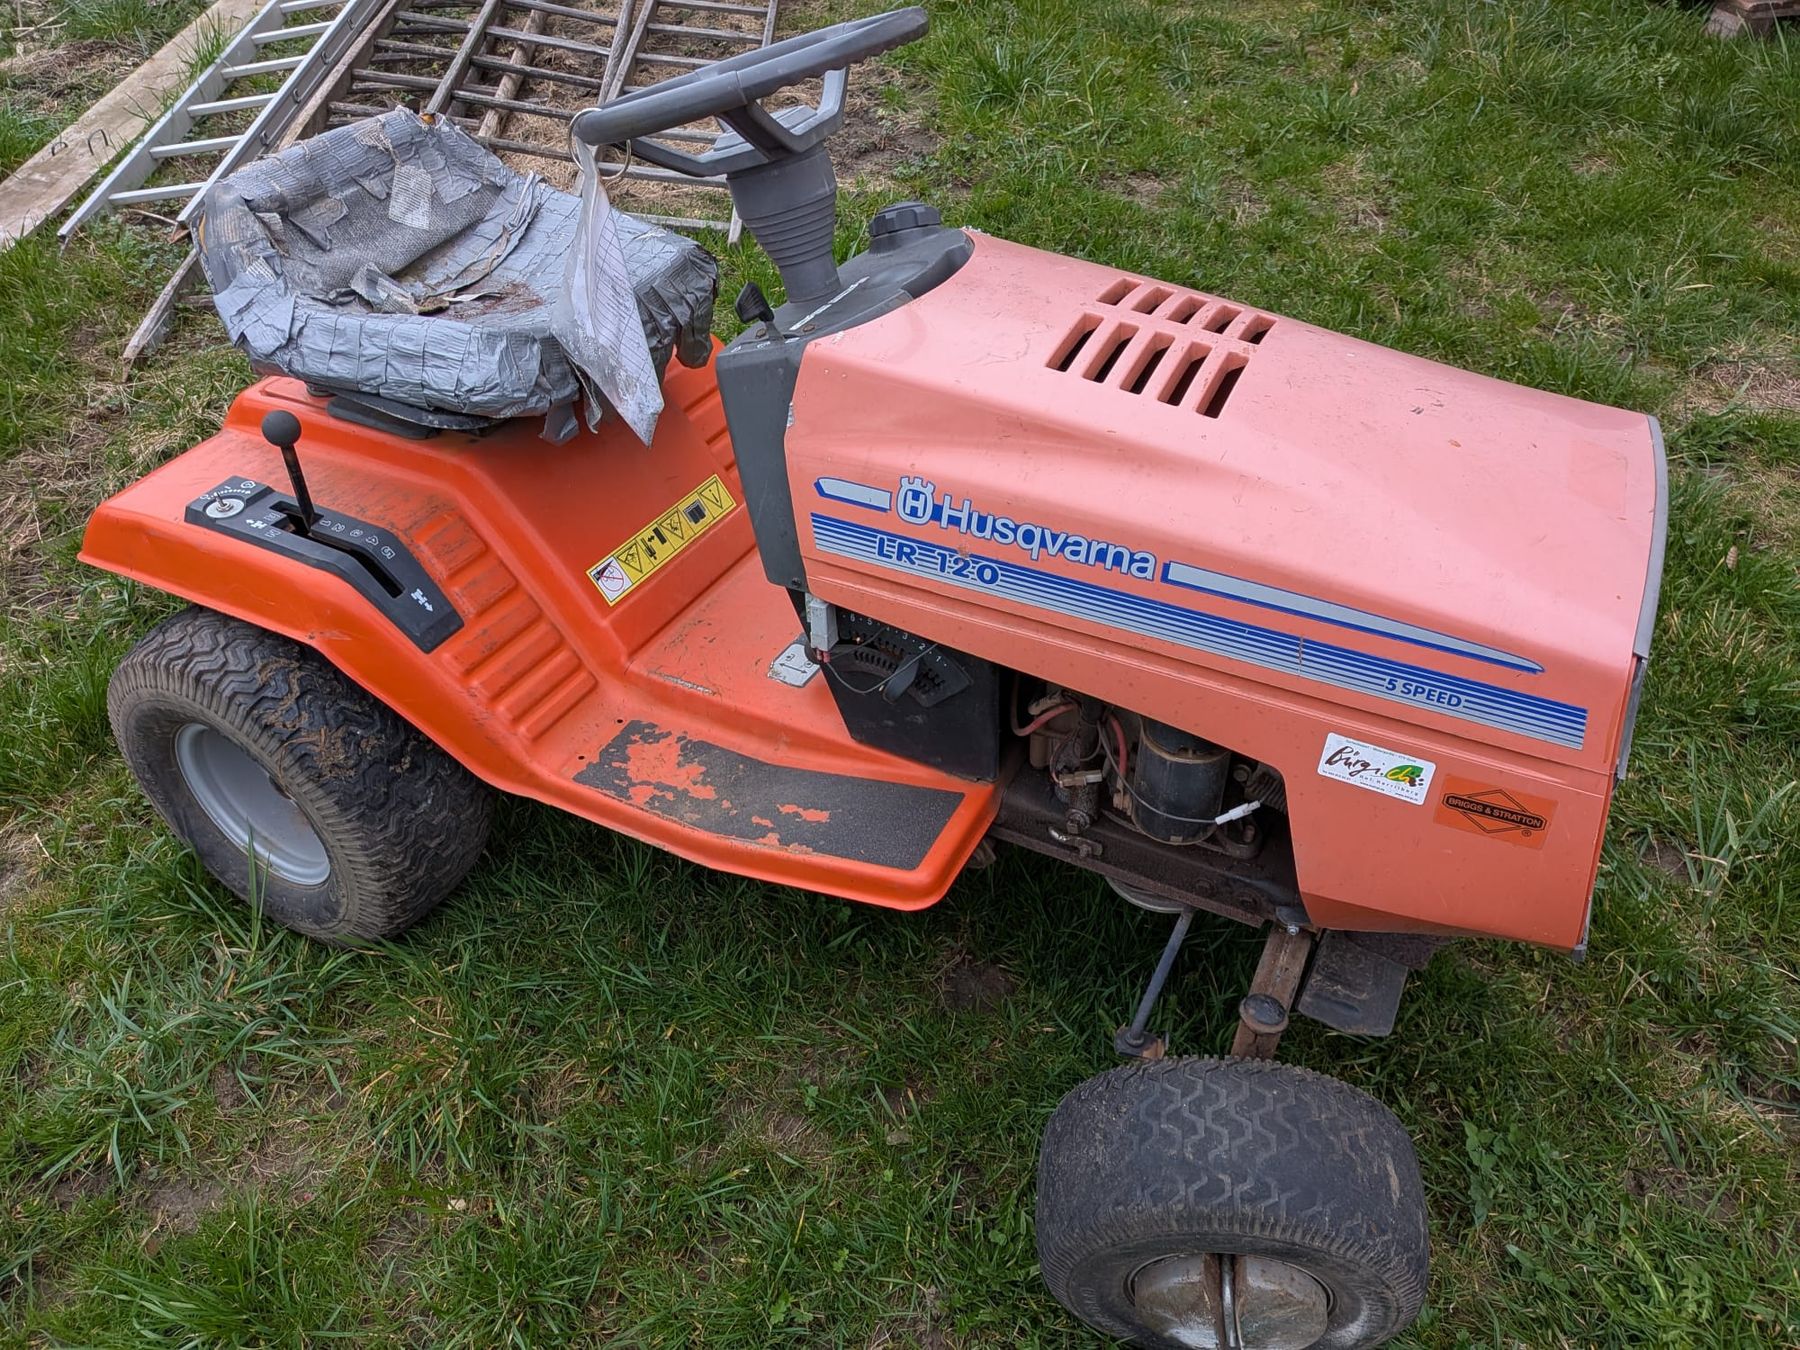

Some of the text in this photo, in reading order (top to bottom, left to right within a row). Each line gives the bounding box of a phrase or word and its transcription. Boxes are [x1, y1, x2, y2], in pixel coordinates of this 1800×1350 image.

[940, 493, 1157, 581] Husqvarna
[876, 536, 1000, 585] LR 120
[1385, 677, 1463, 708] 5 SPEED
[1448, 797, 1542, 828] BRIGGS & STRATTON
